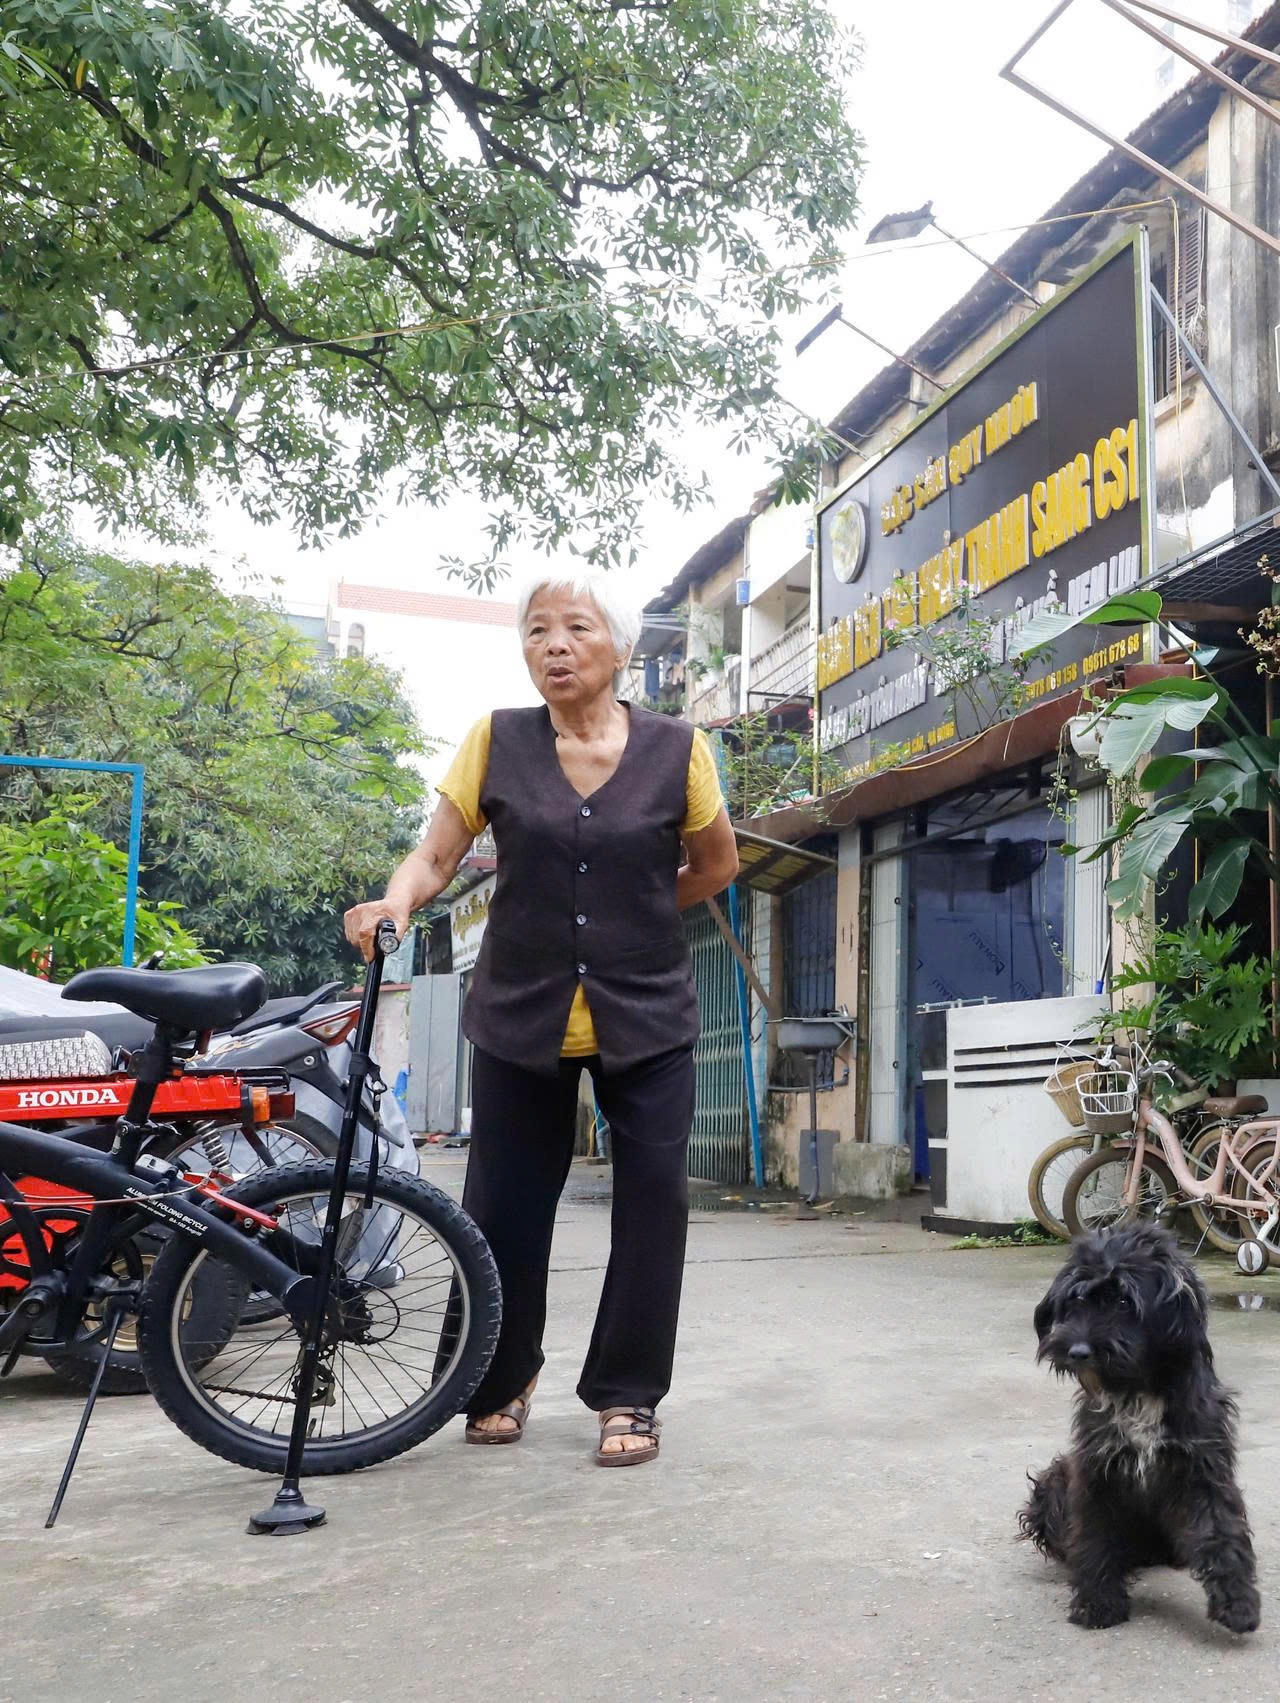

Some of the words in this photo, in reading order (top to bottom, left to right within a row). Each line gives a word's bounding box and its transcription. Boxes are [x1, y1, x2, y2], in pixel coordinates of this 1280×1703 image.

[949, 425, 983, 485] QUY
[965, 493, 1030, 598] THANH
[1031, 453, 1092, 557] SANG
[1093, 418, 1140, 520] CS1
[1068, 562, 1107, 616] NEM
[1108, 639, 1126, 664] 678
[17, 1088, 120, 1108] HONDA
[157, 1202, 184, 1220] FOLDING
[181, 1215, 209, 1232] BICYCLE
